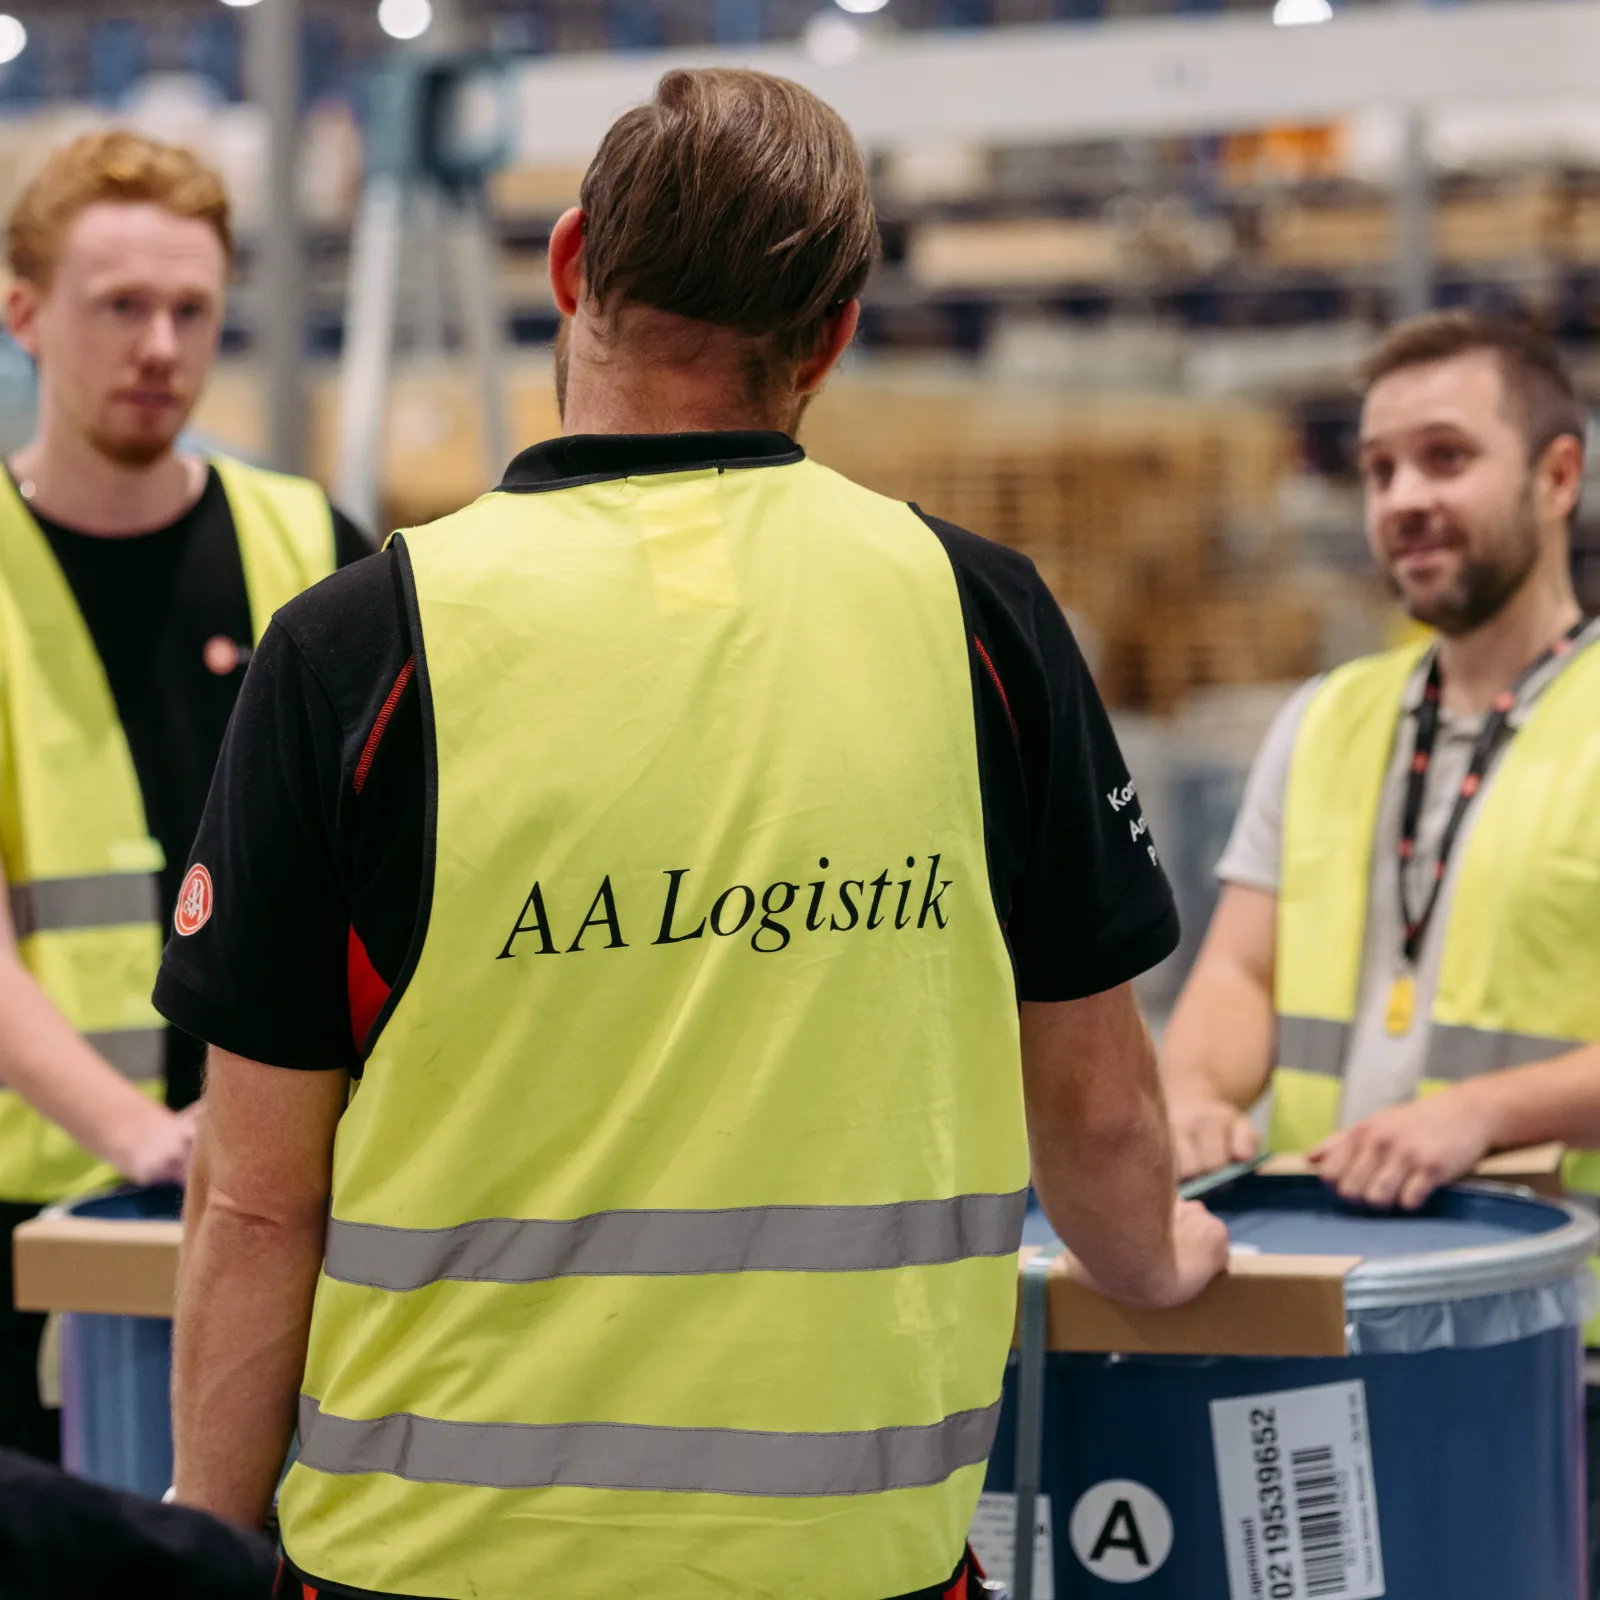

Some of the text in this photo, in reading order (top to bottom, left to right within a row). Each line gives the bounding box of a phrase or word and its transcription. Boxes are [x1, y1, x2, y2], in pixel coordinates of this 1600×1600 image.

[496, 853, 953, 960] AA Logistik
[1088, 1498, 1151, 1568] A
[1249, 1406, 1296, 1600] 0219539652
